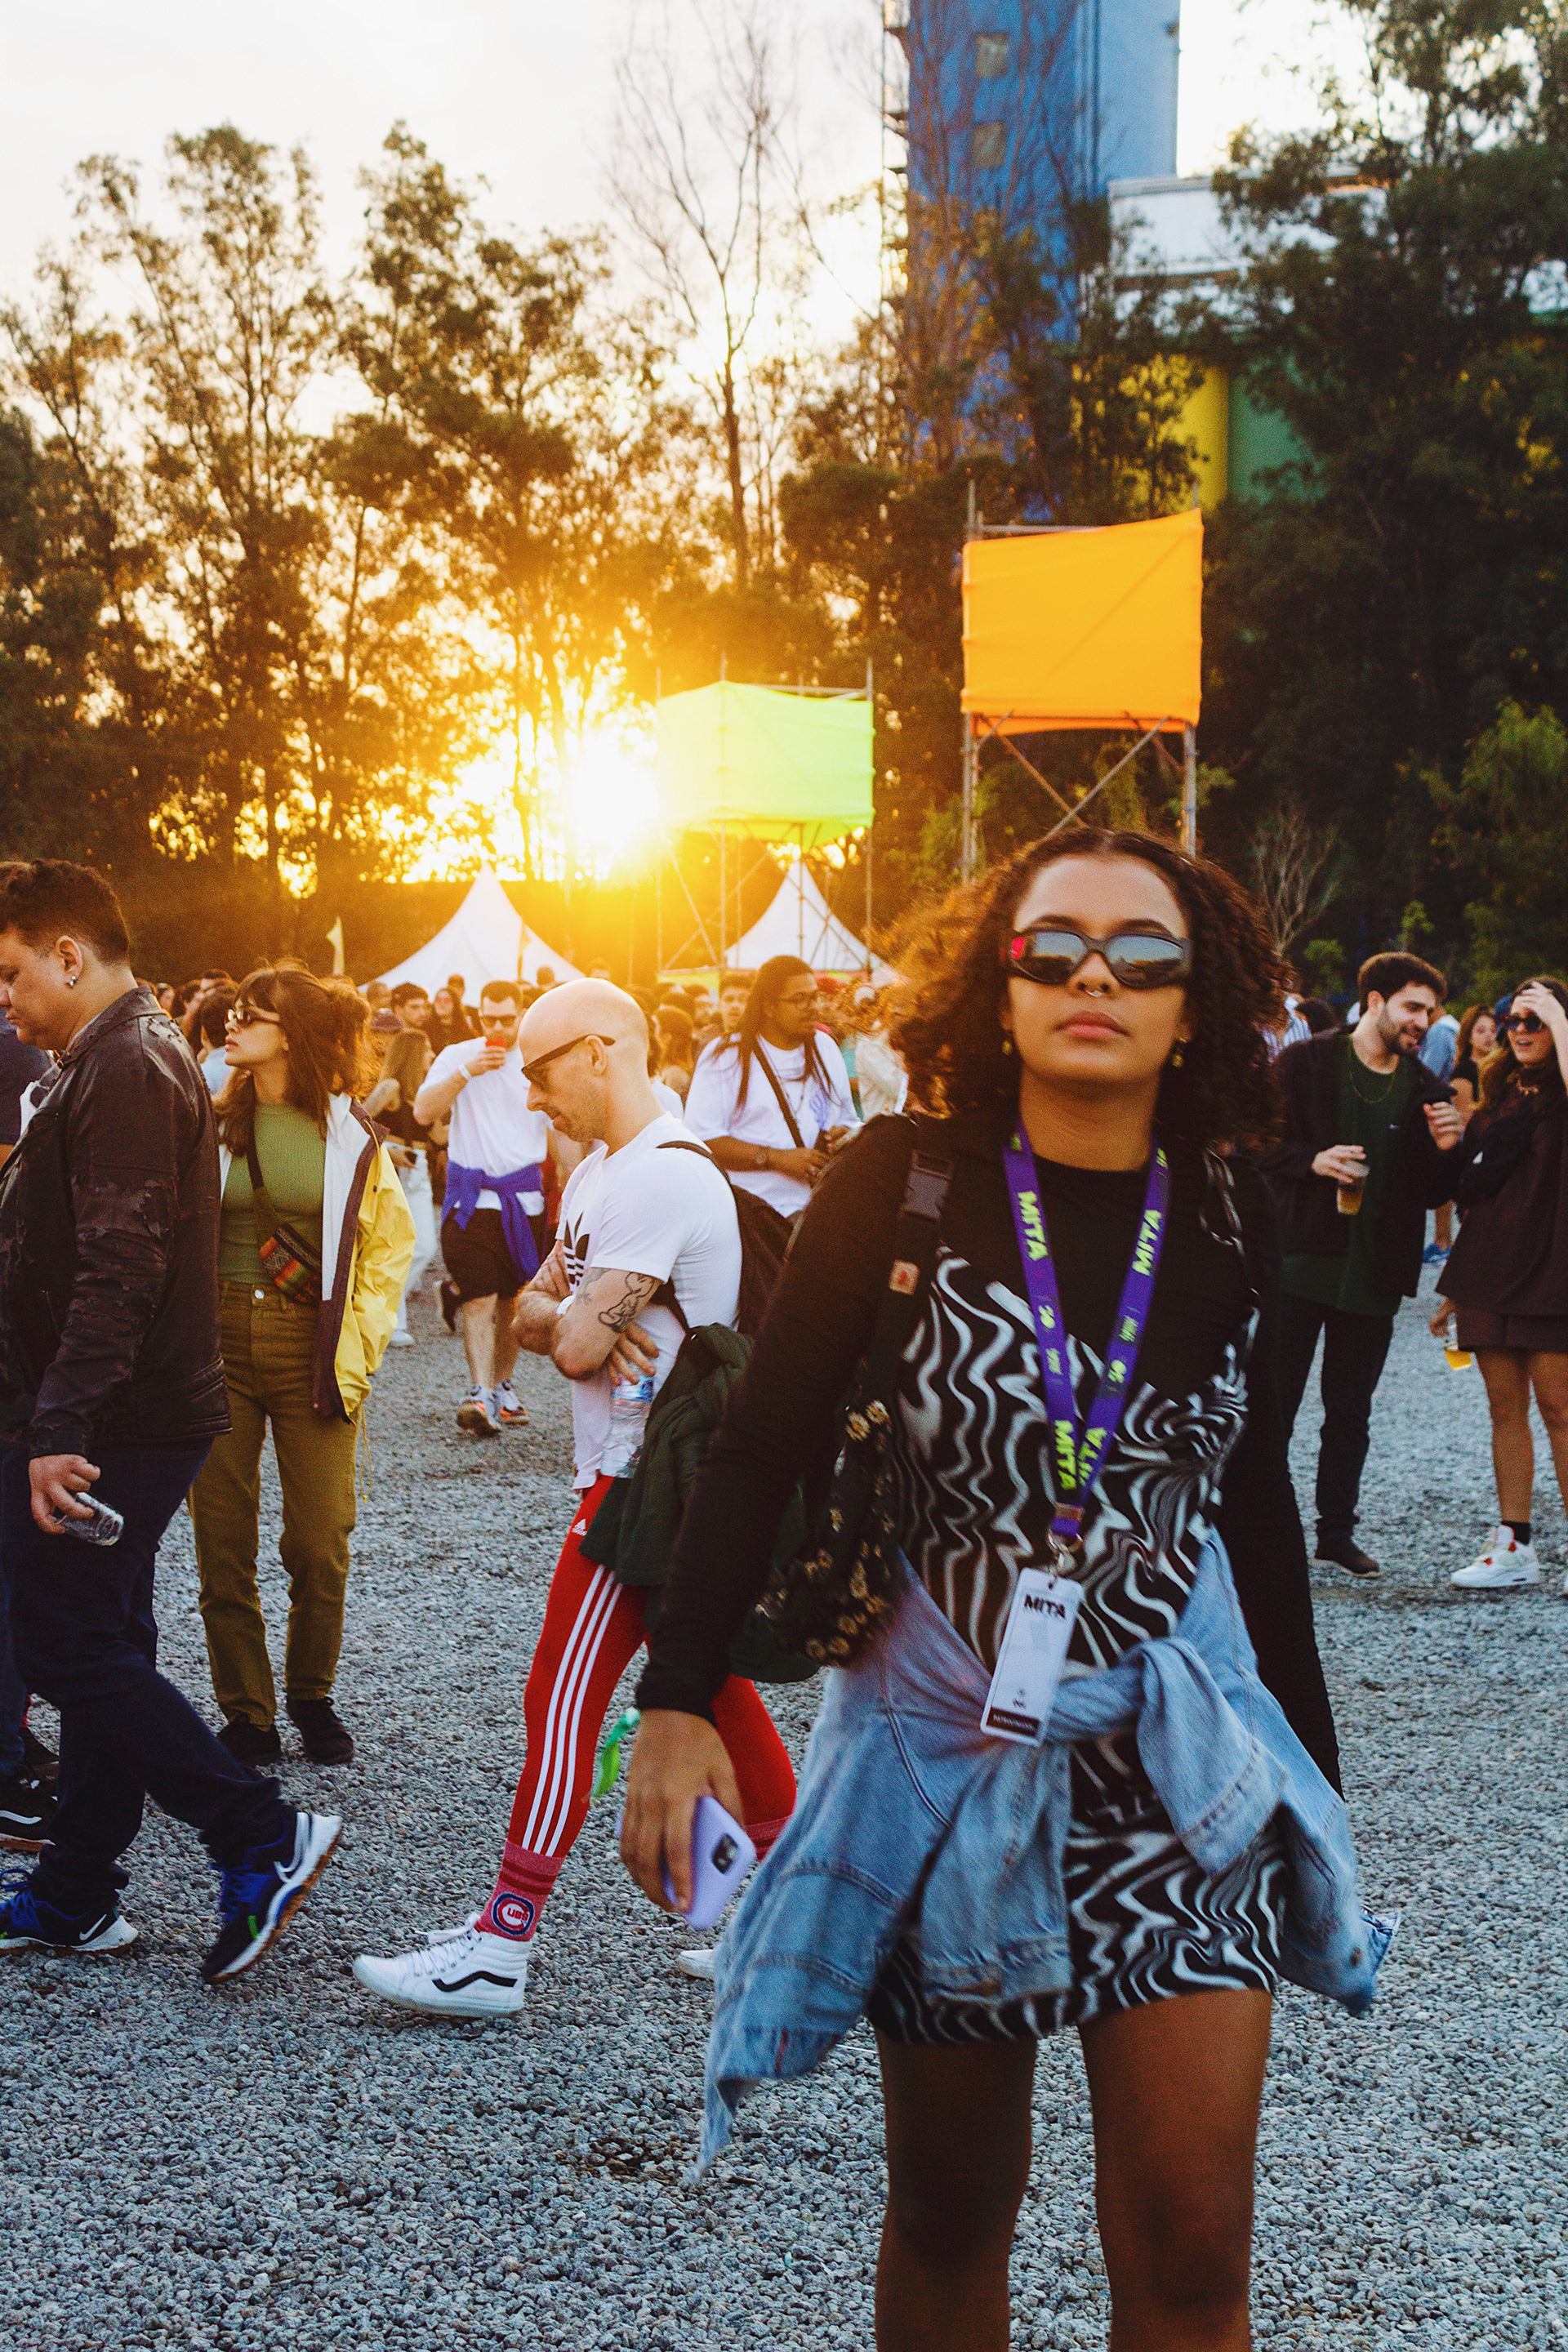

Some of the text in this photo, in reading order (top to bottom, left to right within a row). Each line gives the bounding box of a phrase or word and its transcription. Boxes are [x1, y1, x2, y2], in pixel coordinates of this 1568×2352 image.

[1018, 1191, 1049, 1261] MITA
[1131, 1209, 1161, 1276] MITA
[1023, 1593, 1066, 1620] MITA
